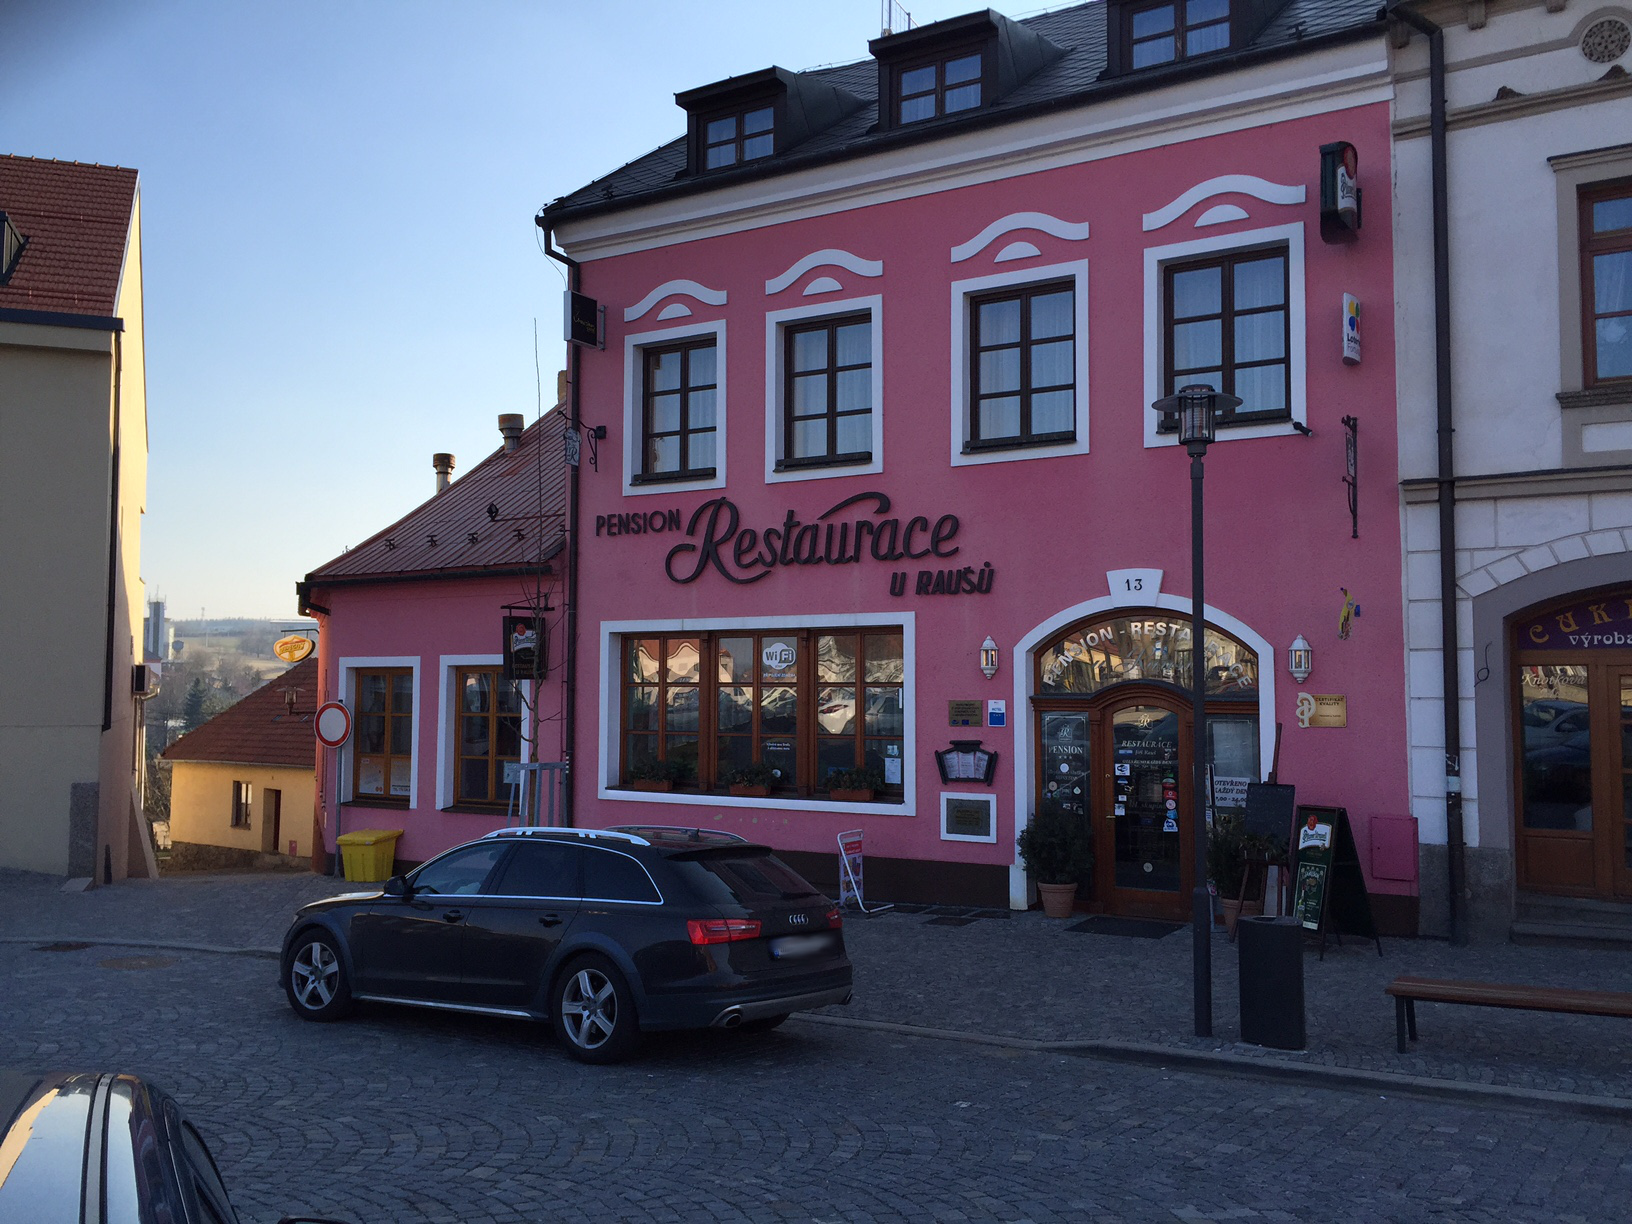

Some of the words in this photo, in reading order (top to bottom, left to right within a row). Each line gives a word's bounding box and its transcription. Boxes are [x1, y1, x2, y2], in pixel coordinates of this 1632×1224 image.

[595, 508, 680, 537] PENSION
[664, 491, 960, 585] Restaurace
[889, 571, 907, 597] U
[915, 561, 995, 596] RAUŠŮ
[1125, 578, 1143, 591] 13
[765, 650, 794, 662] WiFi
[1043, 626, 1113, 687] PENSION
[1130, 621, 1253, 689] RESTARACE
[1121, 740, 1173, 748] RESTAURACE
